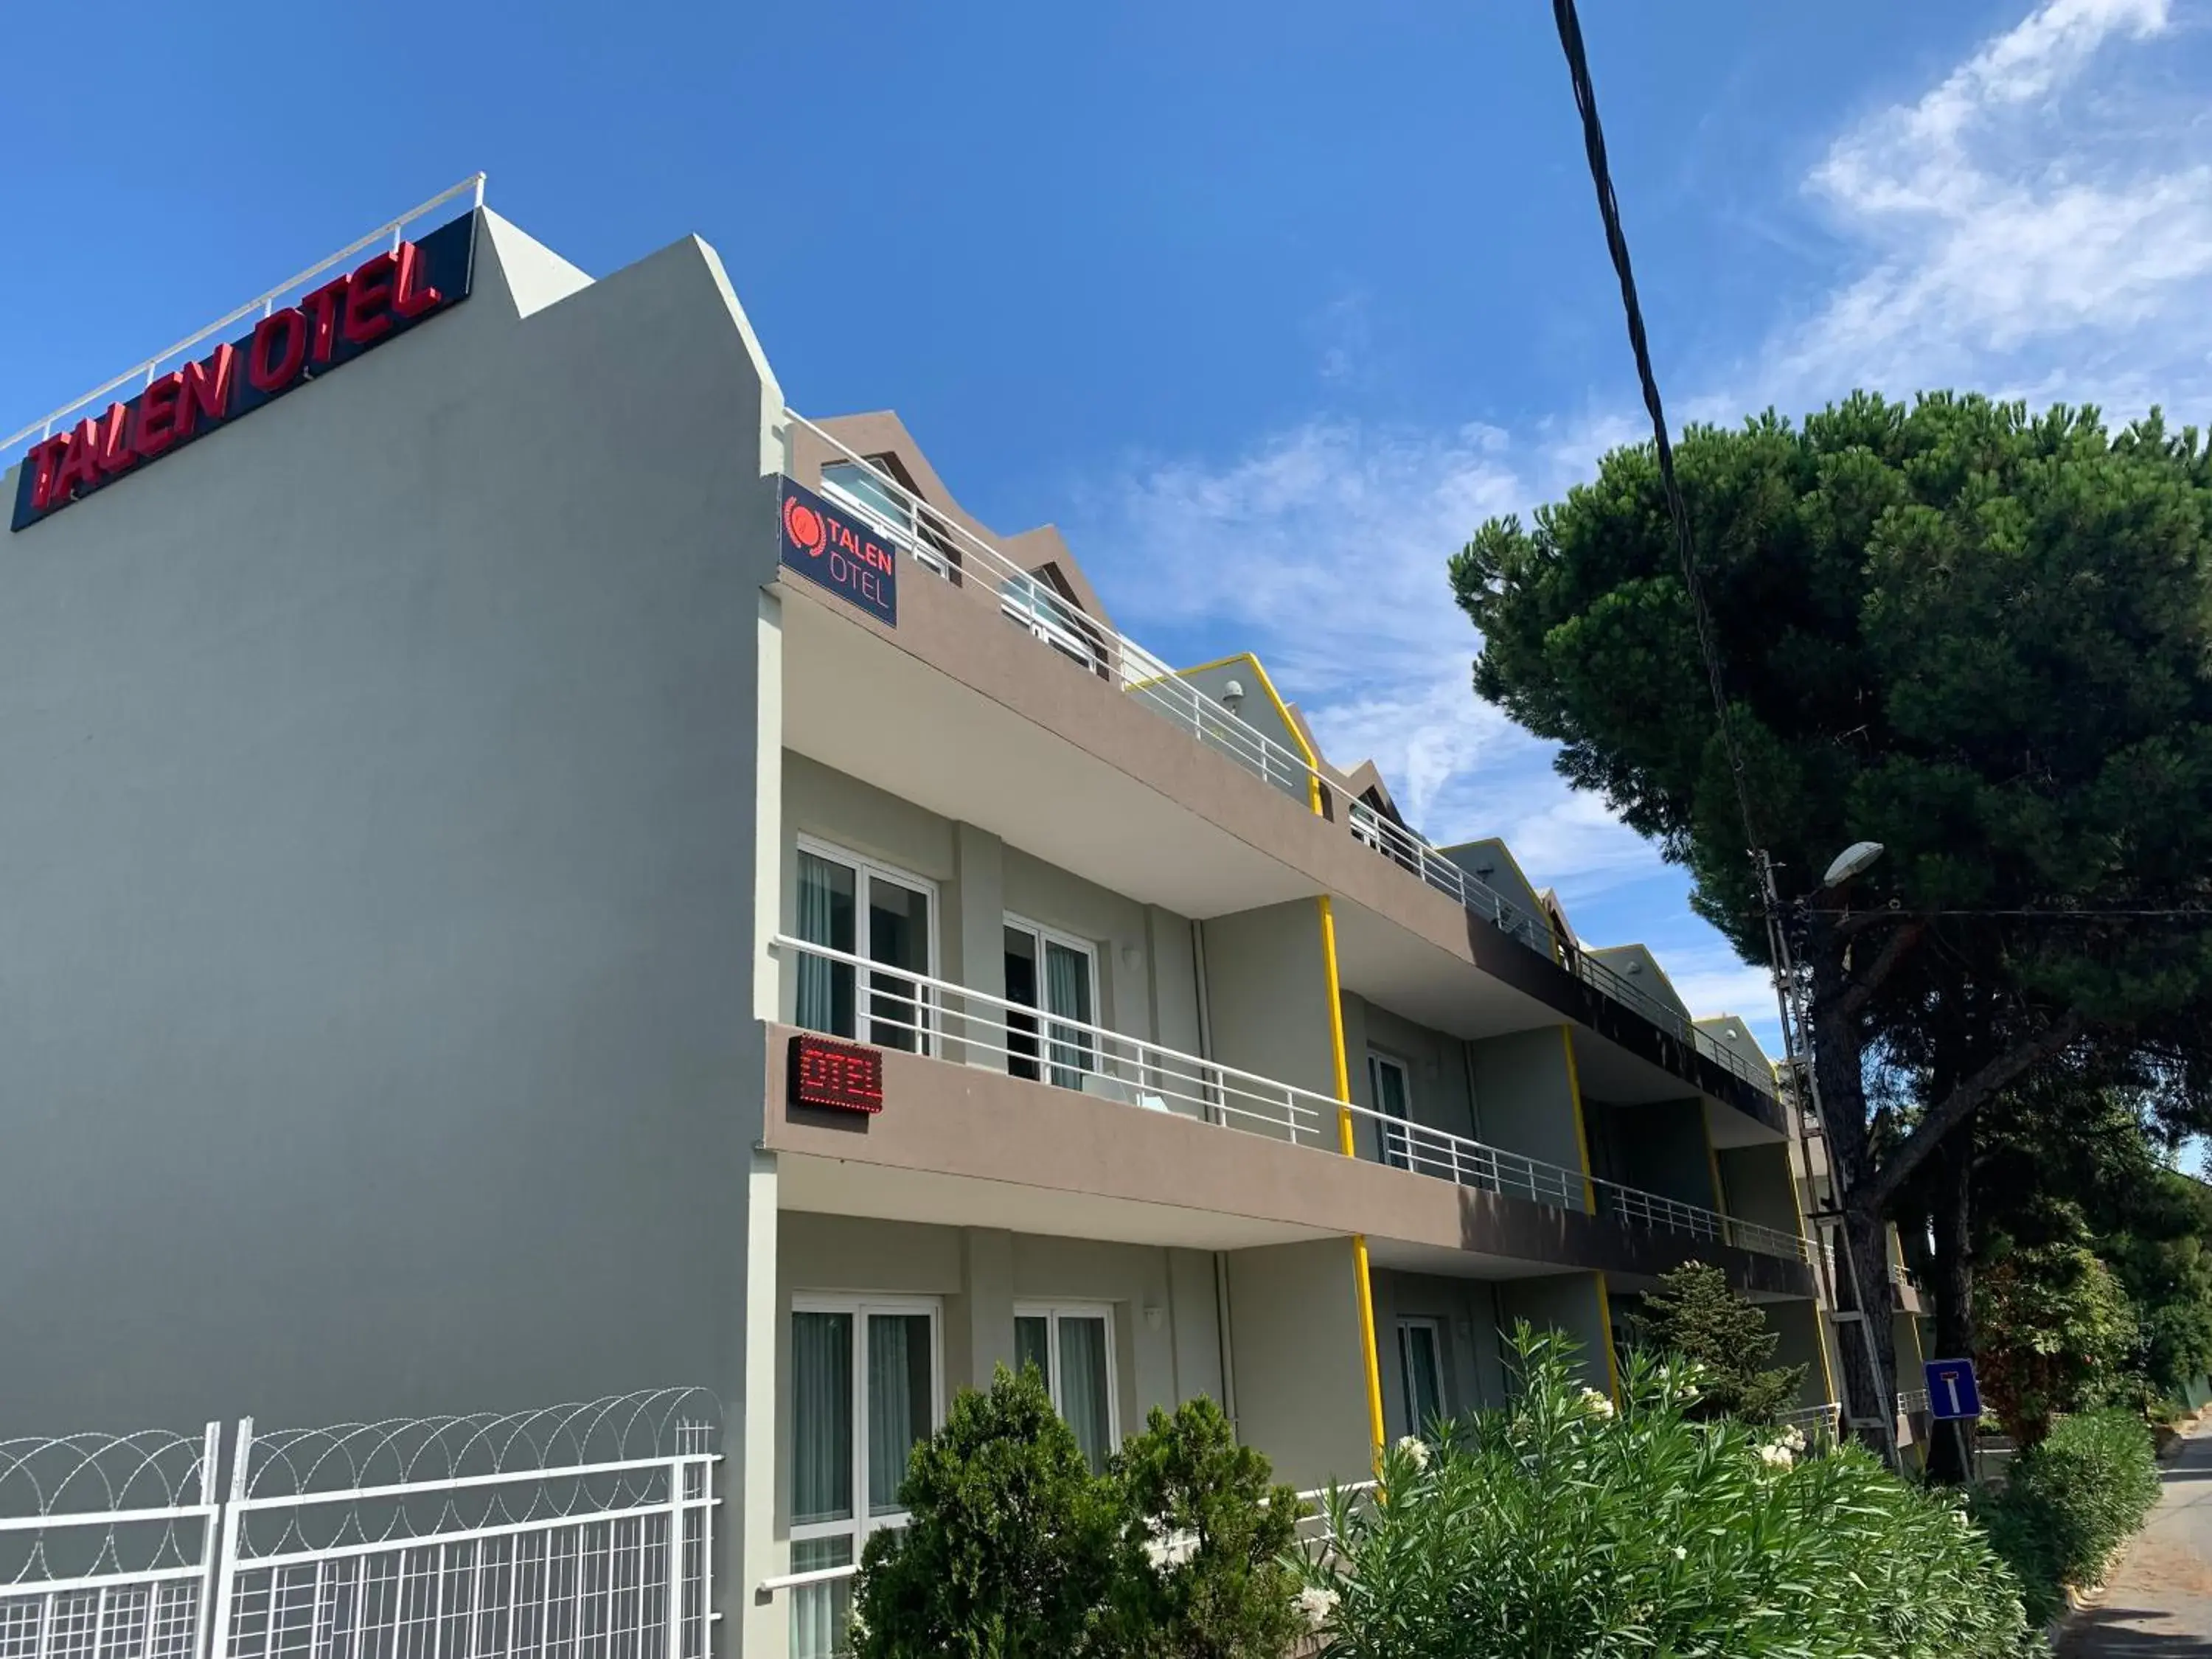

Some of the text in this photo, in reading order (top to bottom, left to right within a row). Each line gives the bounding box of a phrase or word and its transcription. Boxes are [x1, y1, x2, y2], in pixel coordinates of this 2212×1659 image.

[28, 240, 442, 511] TALEN OTEL
[827, 517, 892, 576] TALEN
[830, 551, 889, 609] OTEL
[801, 1049, 883, 1098] OTEL
